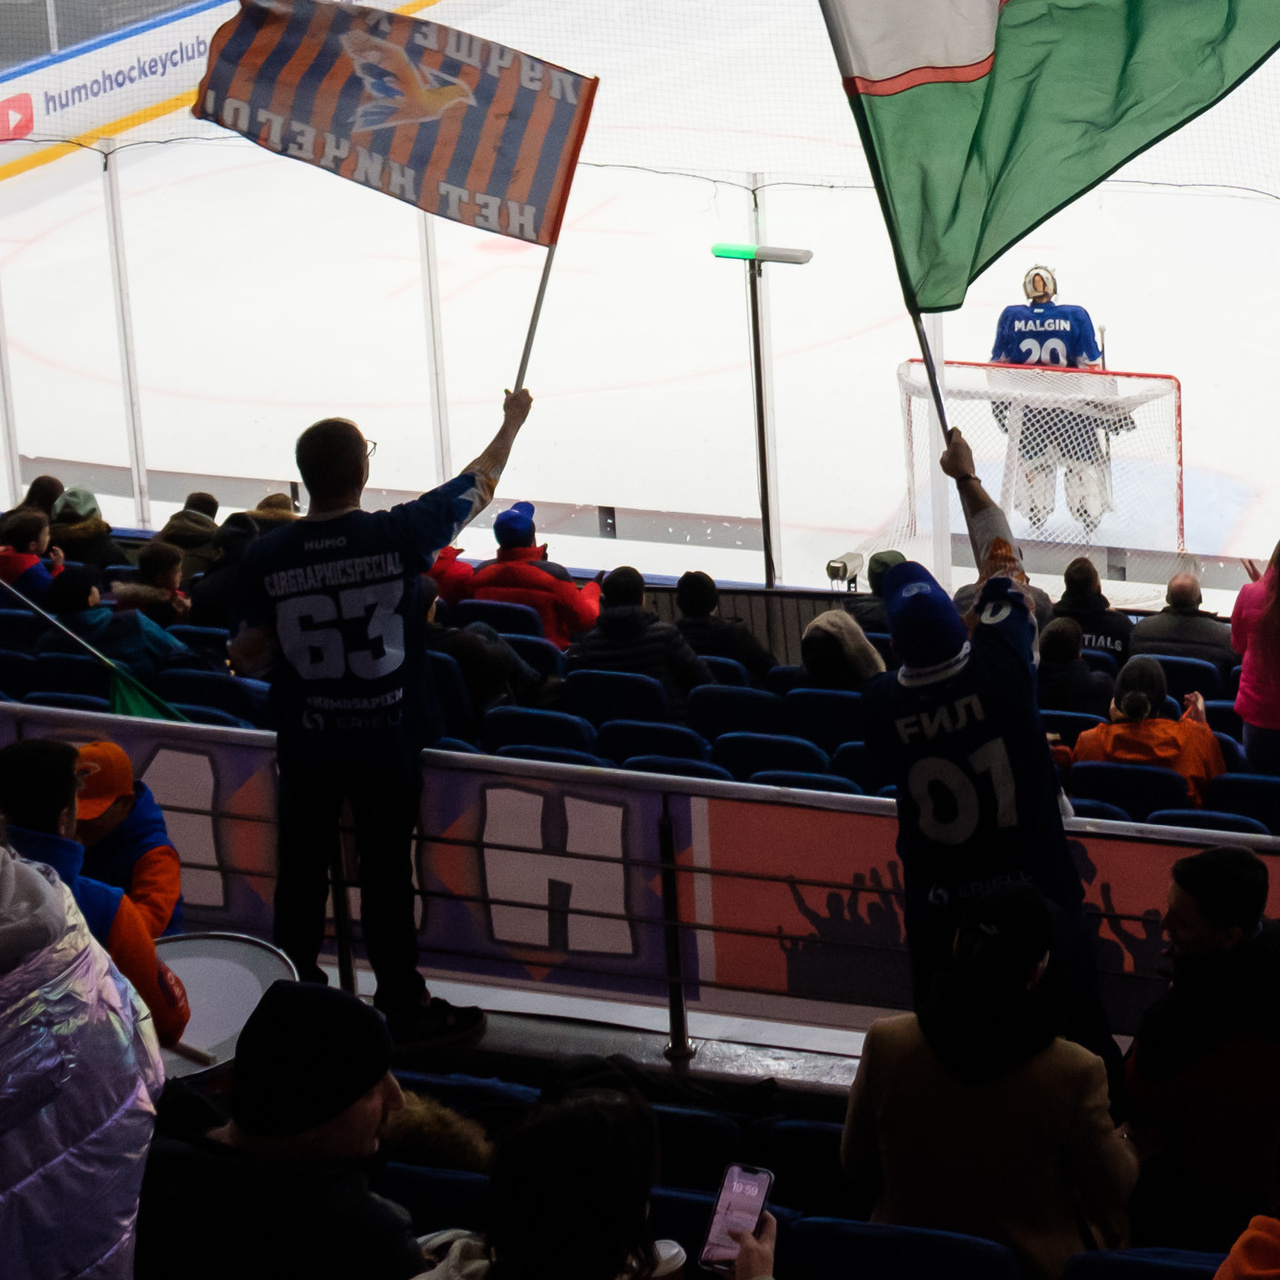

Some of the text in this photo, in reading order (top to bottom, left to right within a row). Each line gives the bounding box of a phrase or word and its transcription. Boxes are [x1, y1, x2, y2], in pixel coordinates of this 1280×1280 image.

[43, 35, 209, 115] humohockeyclub
[1014, 319, 1071, 331] MALGIN
[1019, 338, 1067, 367] 20
[303, 536, 348, 551] HUMO
[275, 579, 405, 680] 63
[1082, 634, 1123, 651] TIALS
[907, 736, 1019, 846] 01
